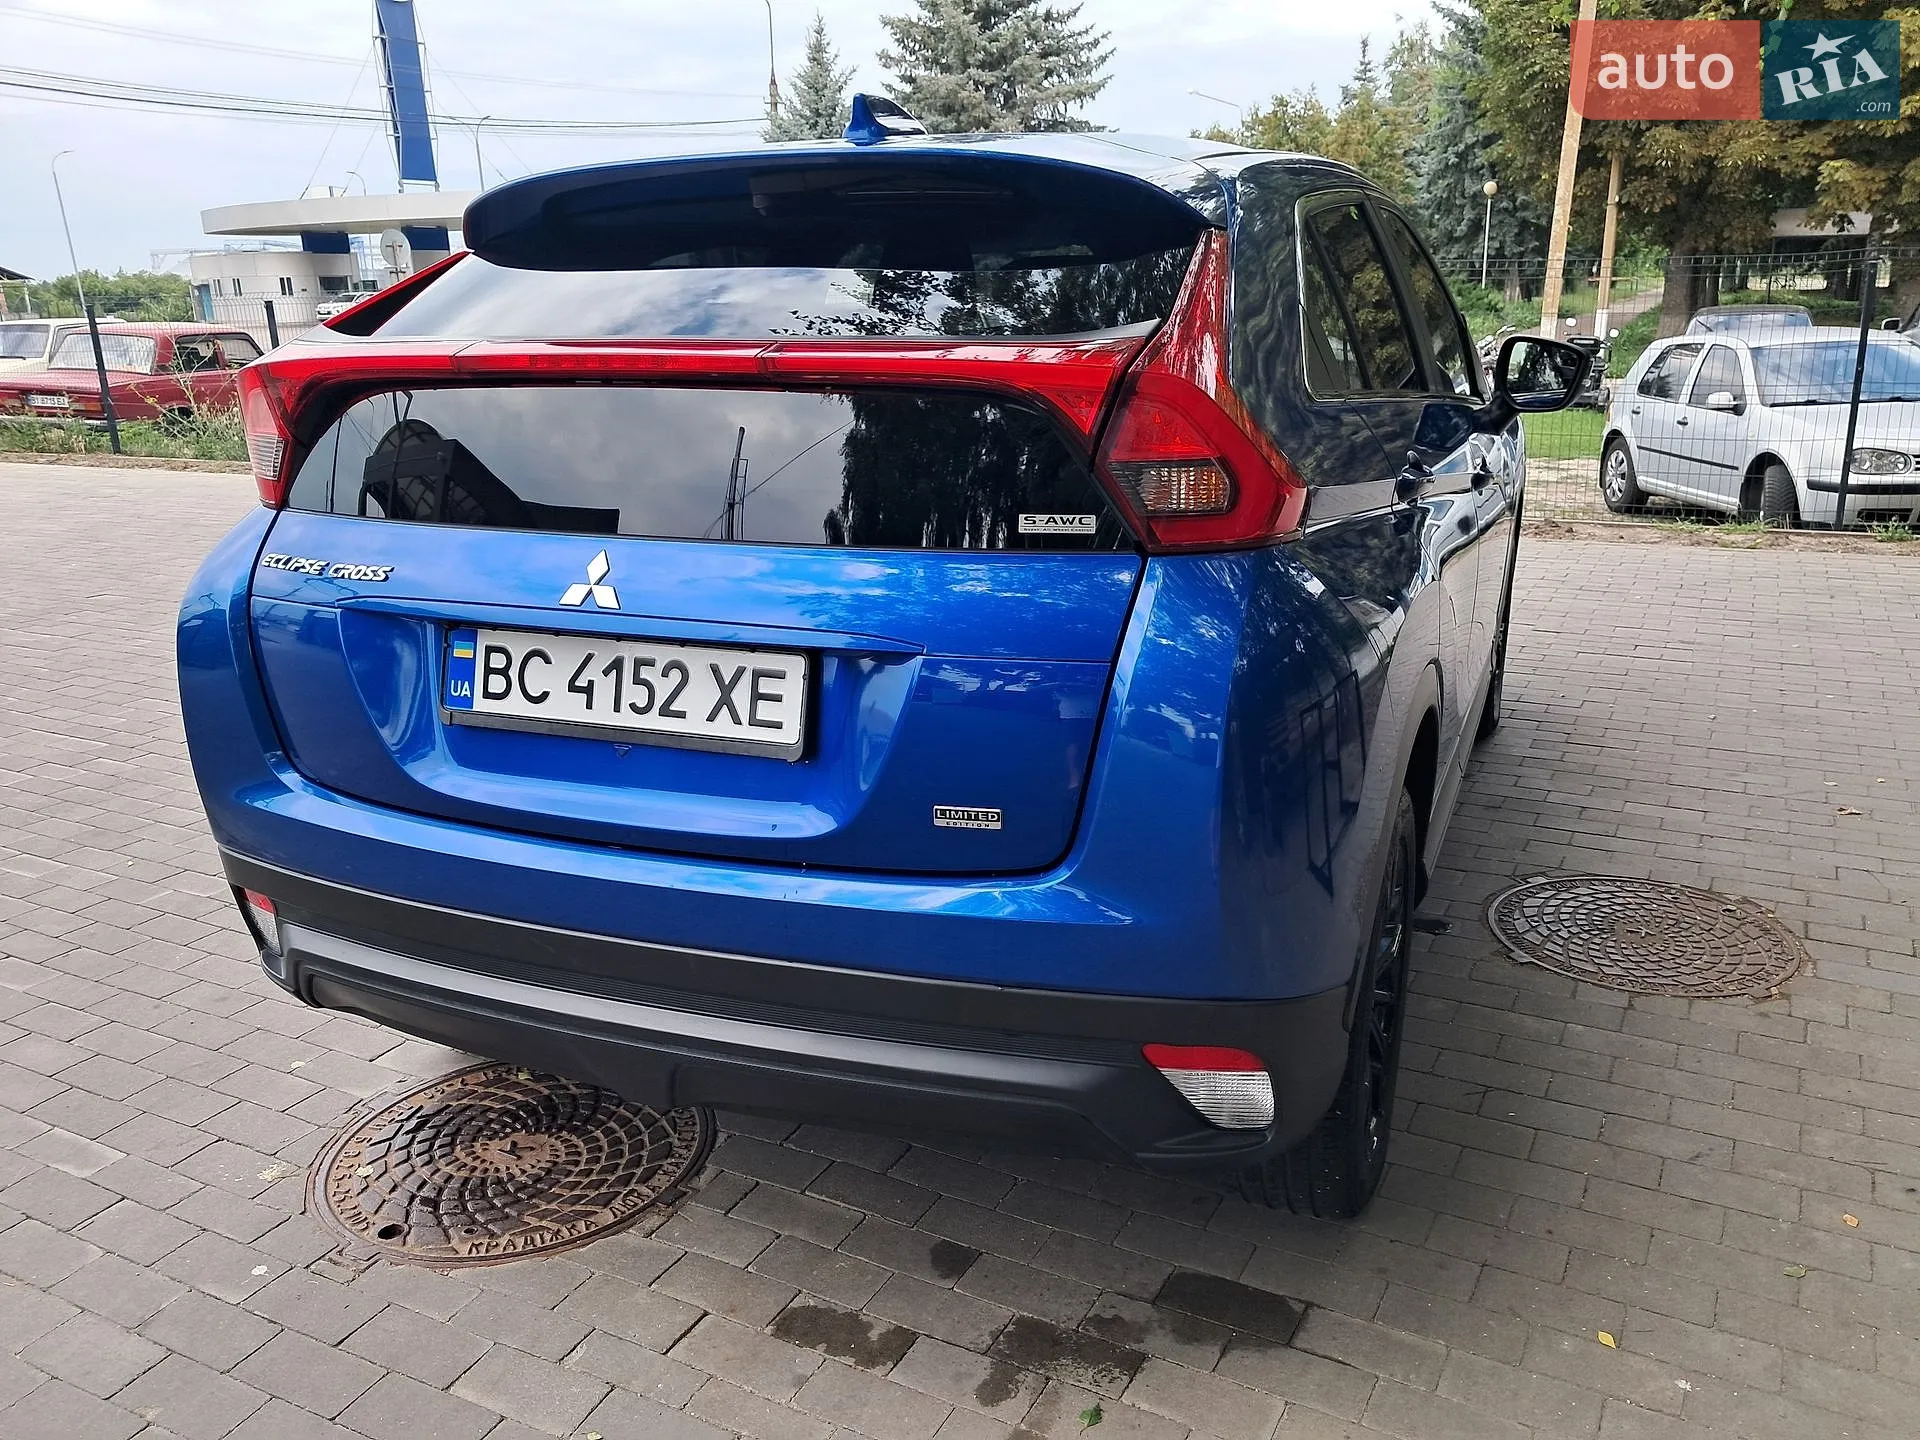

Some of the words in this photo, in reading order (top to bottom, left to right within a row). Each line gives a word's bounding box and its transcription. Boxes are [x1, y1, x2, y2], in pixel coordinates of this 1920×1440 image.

[1023, 515, 1092, 526] S-AWC
[261, 553, 329, 575] ECLIPSE
[328, 563, 393, 581] CROSS
[451, 679, 472, 698] UA
[482, 644, 552, 705] BC
[567, 652, 690, 720] 4152
[705, 663, 787, 730] XE
[936, 809, 998, 821] LIMITED
[467, 1219, 600, 1256] КРАДІЖКА
